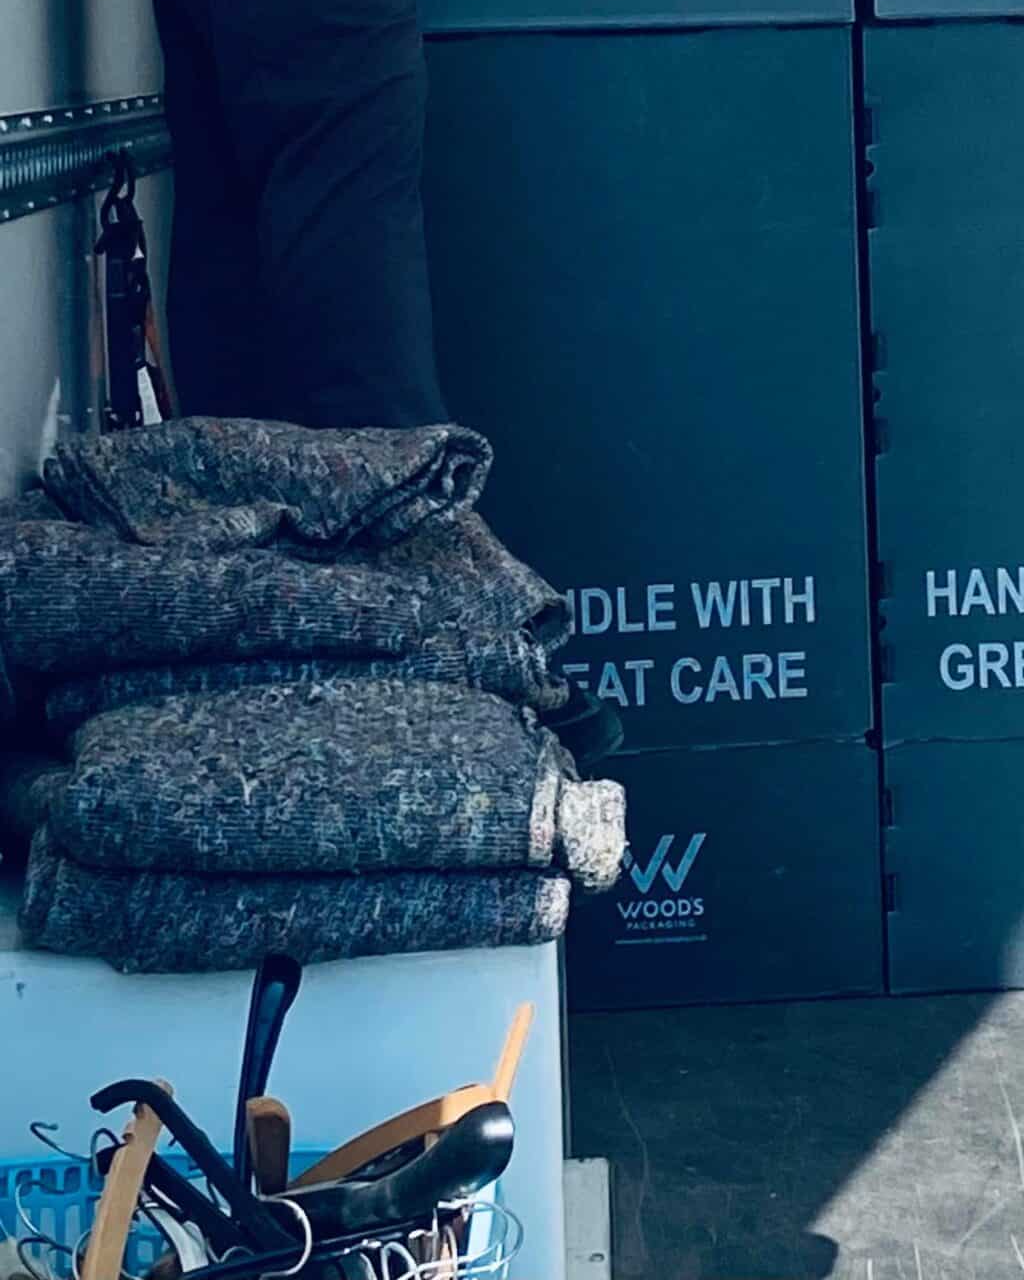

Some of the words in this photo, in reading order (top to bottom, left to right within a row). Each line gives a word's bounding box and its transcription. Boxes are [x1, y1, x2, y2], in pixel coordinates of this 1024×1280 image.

[567, 583, 676, 635] DLE
[691, 576, 814, 627] WITH
[671, 652, 807, 703] CARE
[617, 897, 704, 919] WOOD'S
[626, 919, 696, 930] PACKAGING
